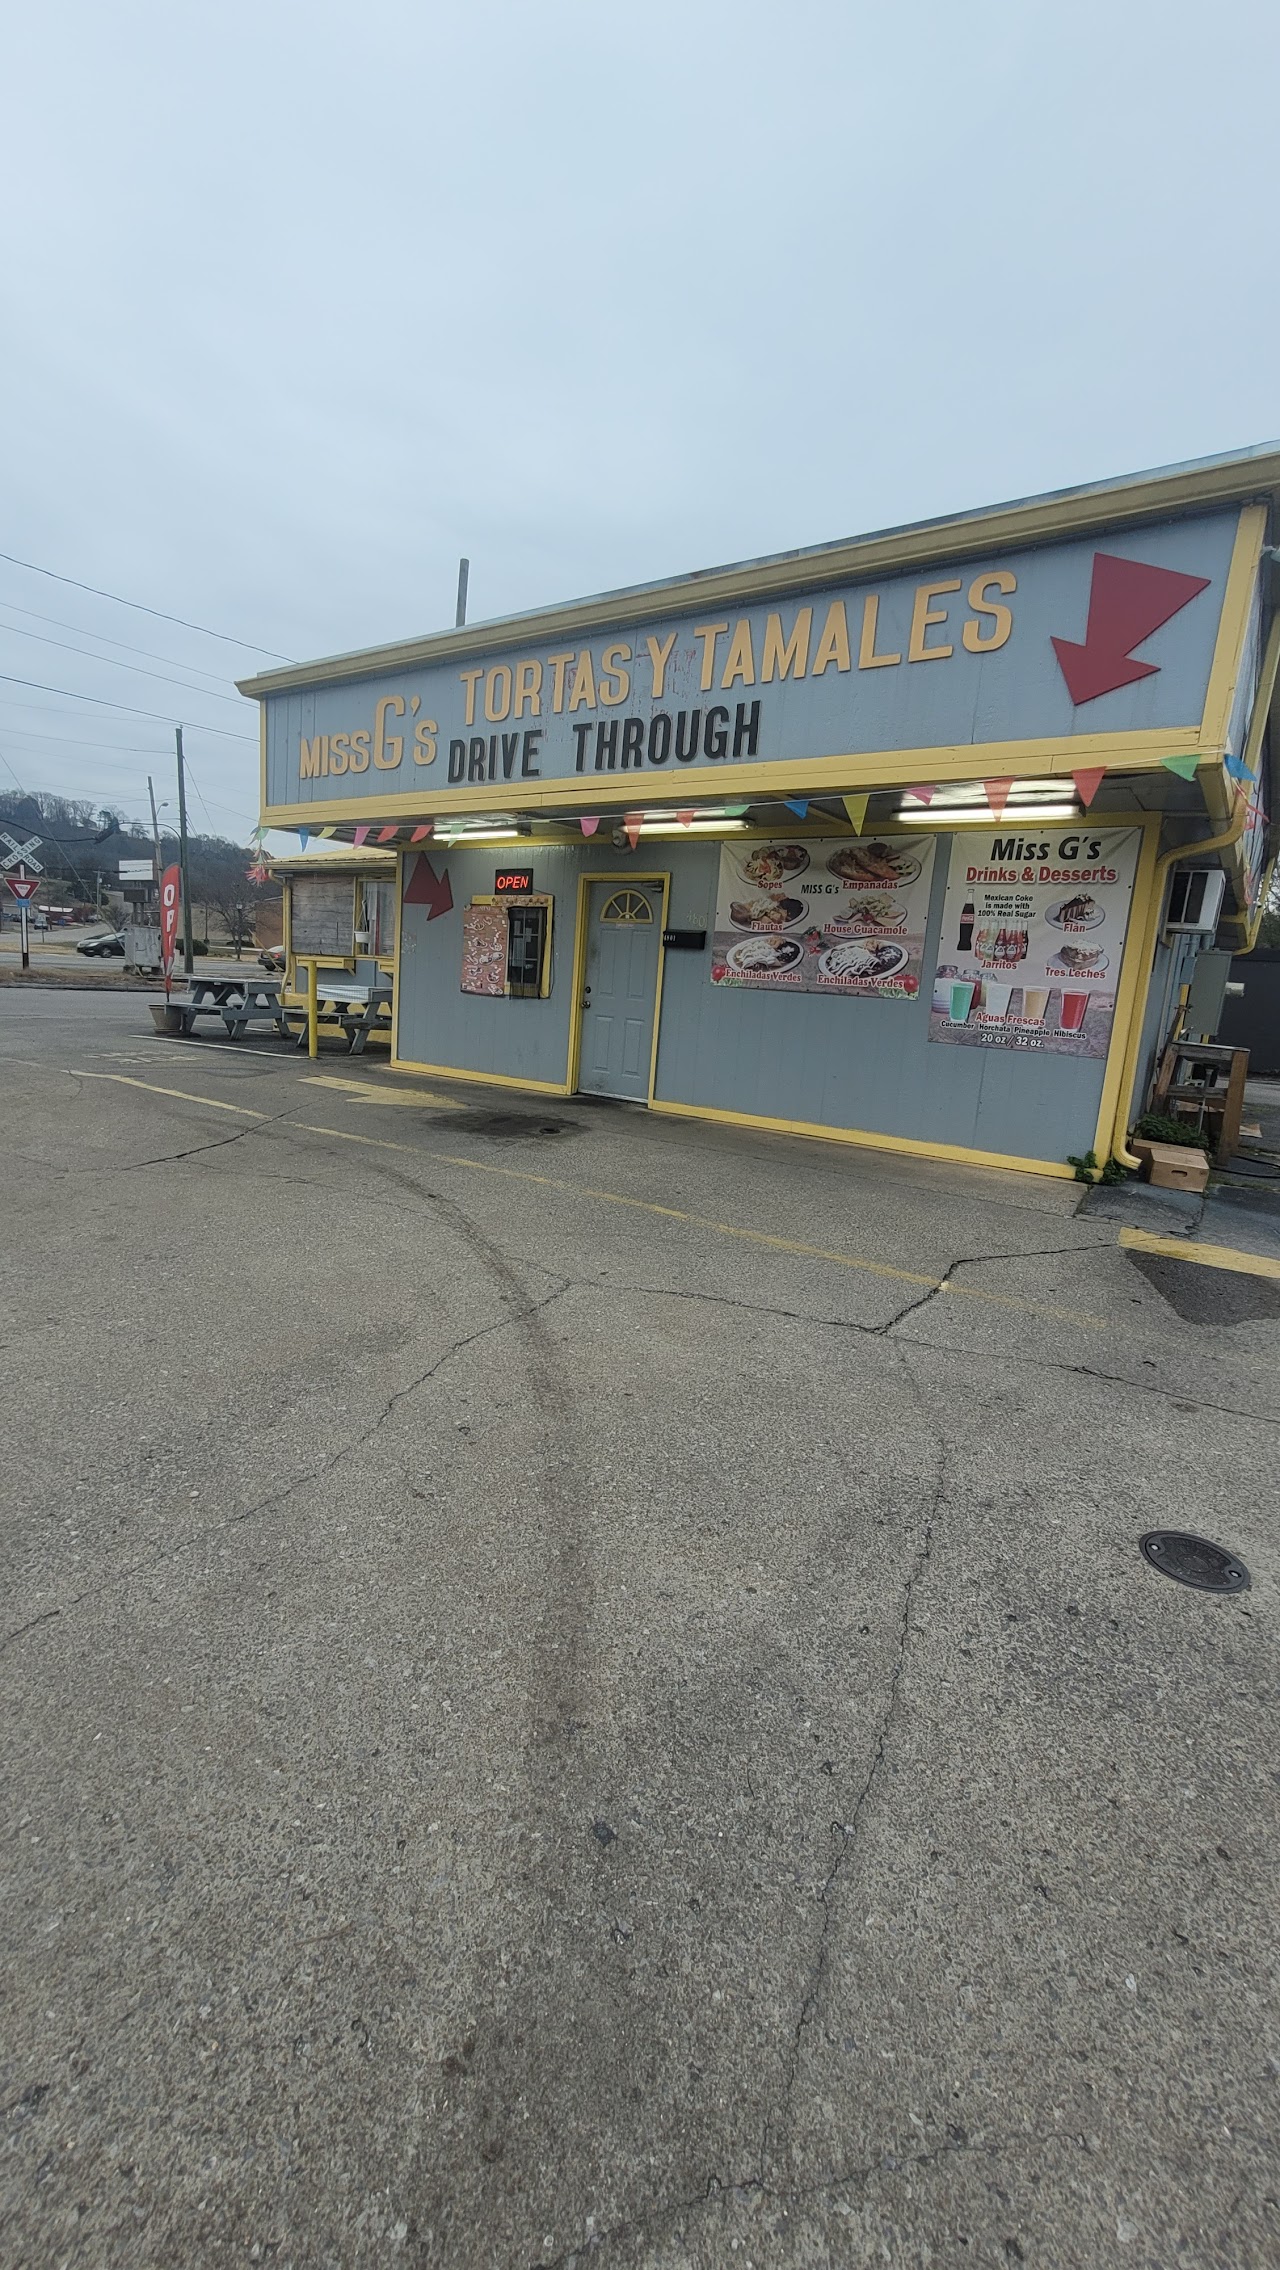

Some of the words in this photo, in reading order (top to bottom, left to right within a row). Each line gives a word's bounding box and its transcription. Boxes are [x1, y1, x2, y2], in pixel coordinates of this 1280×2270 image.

[460, 644, 631, 726] TORTAS
[647, 632, 678, 698] Y
[694, 570, 1018, 691] TAMALES
[301, 730, 370, 779] MISS
[373, 696, 438, 770] G's
[448, 729, 542, 783] DRIVE
[572, 701, 762, 772] THROUGH
[990, 838, 1050, 861] Miss
[1058, 836, 1102, 860] G's
[966, 866, 1017, 882] Drinks
[1021, 866, 1035, 882] &
[1038, 866, 1117, 882] Desserts
[497, 876, 529, 889] OPEN
[757, 880, 783, 890] Sopes
[800, 884, 822, 894] MISS
[825, 884, 840, 894] G's
[842, 880, 898, 890] Empanadas
[984, 894, 1014, 902] Mexican
[1015, 894, 1034, 902] Coke
[993, 902, 1013, 910] made
[1014, 902, 1030, 910] with
[1015, 910, 1036, 918] Sugar
[751, 922, 783, 932] Flautas
[824, 924, 852, 934] House
[854, 924, 908, 935] Guacamole
[980, 960, 1018, 970] Jarritos
[725, 968, 771, 980] Enchiladas
[772, 972, 802, 982] Verdes
[1045, 967, 1066, 978] Tres
[1068, 969, 1106, 979] Leches
[818, 975, 868, 986] Enchiladas
[871, 978, 904, 989] Verdes
[976, 1012, 1005, 1023] Aguas
[1007, 1014, 1045, 1026] Frescas
[941, 1020, 974, 1030] Cucumber
[979, 1024, 1011, 1033] Horchata
[1014, 1026, 1050, 1036] Pineapple
[1054, 1030, 1086, 1039] Hibiscus
[980, 1033, 994, 1042] 20
[994, 1035, 1006, 1044] oz
[1015, 1036, 1028, 1046] 32
[1030, 1038, 1044, 1048] oz.
